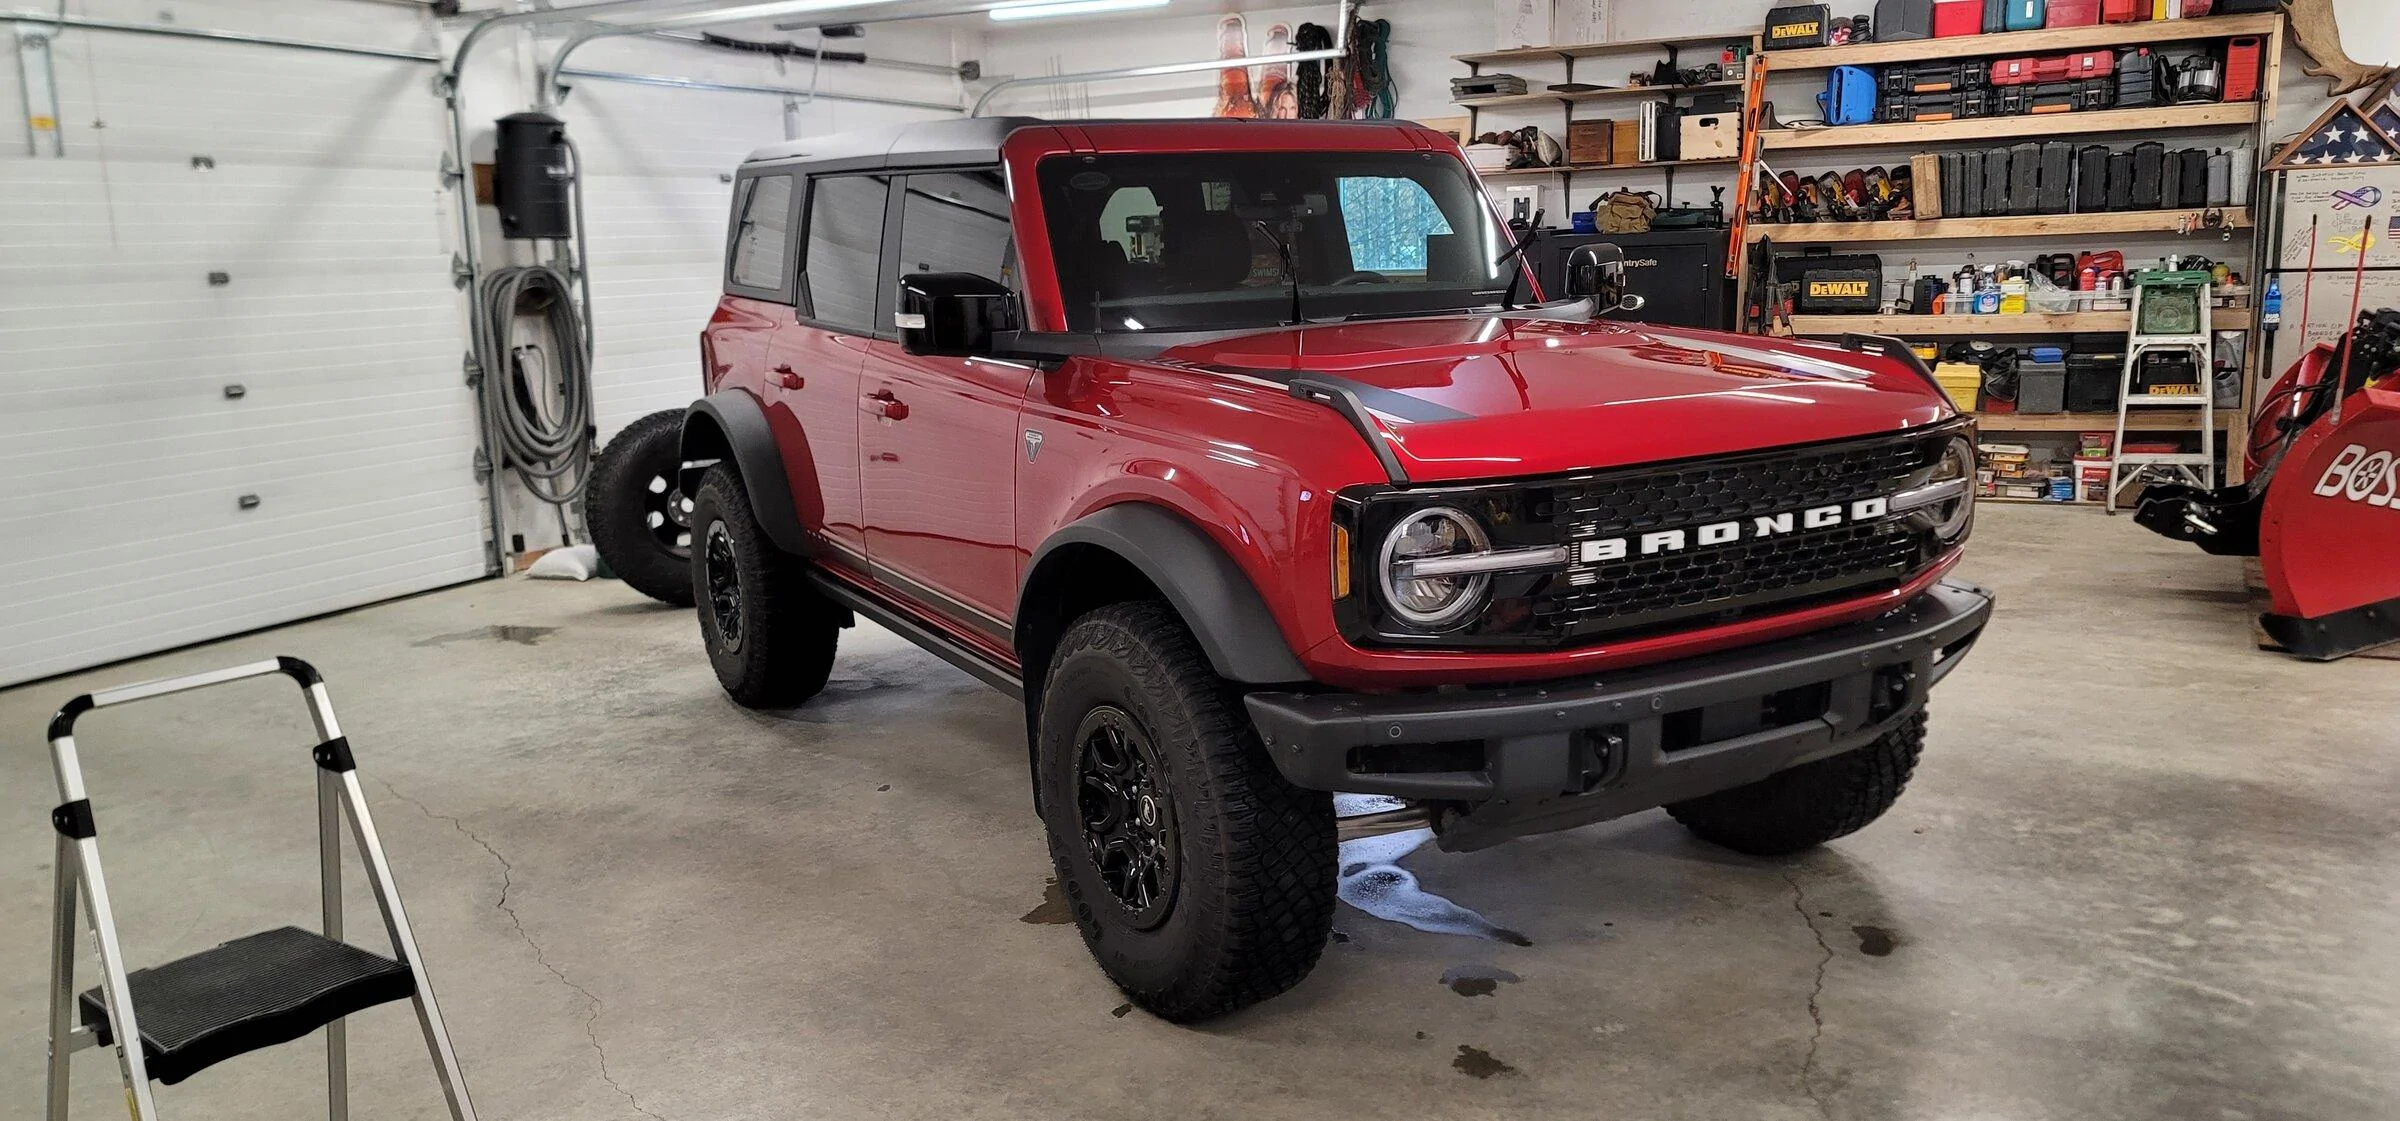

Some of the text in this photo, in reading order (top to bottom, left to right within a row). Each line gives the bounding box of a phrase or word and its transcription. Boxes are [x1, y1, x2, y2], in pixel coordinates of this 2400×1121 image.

[1772, 22, 1818, 38] DEWALT
[1623, 258, 1658, 267] ntrySafe
[1809, 281, 1869, 297] DEWALT
[2312, 443, 2400, 510] BOS
[1580, 496, 1888, 564] BRONCO
